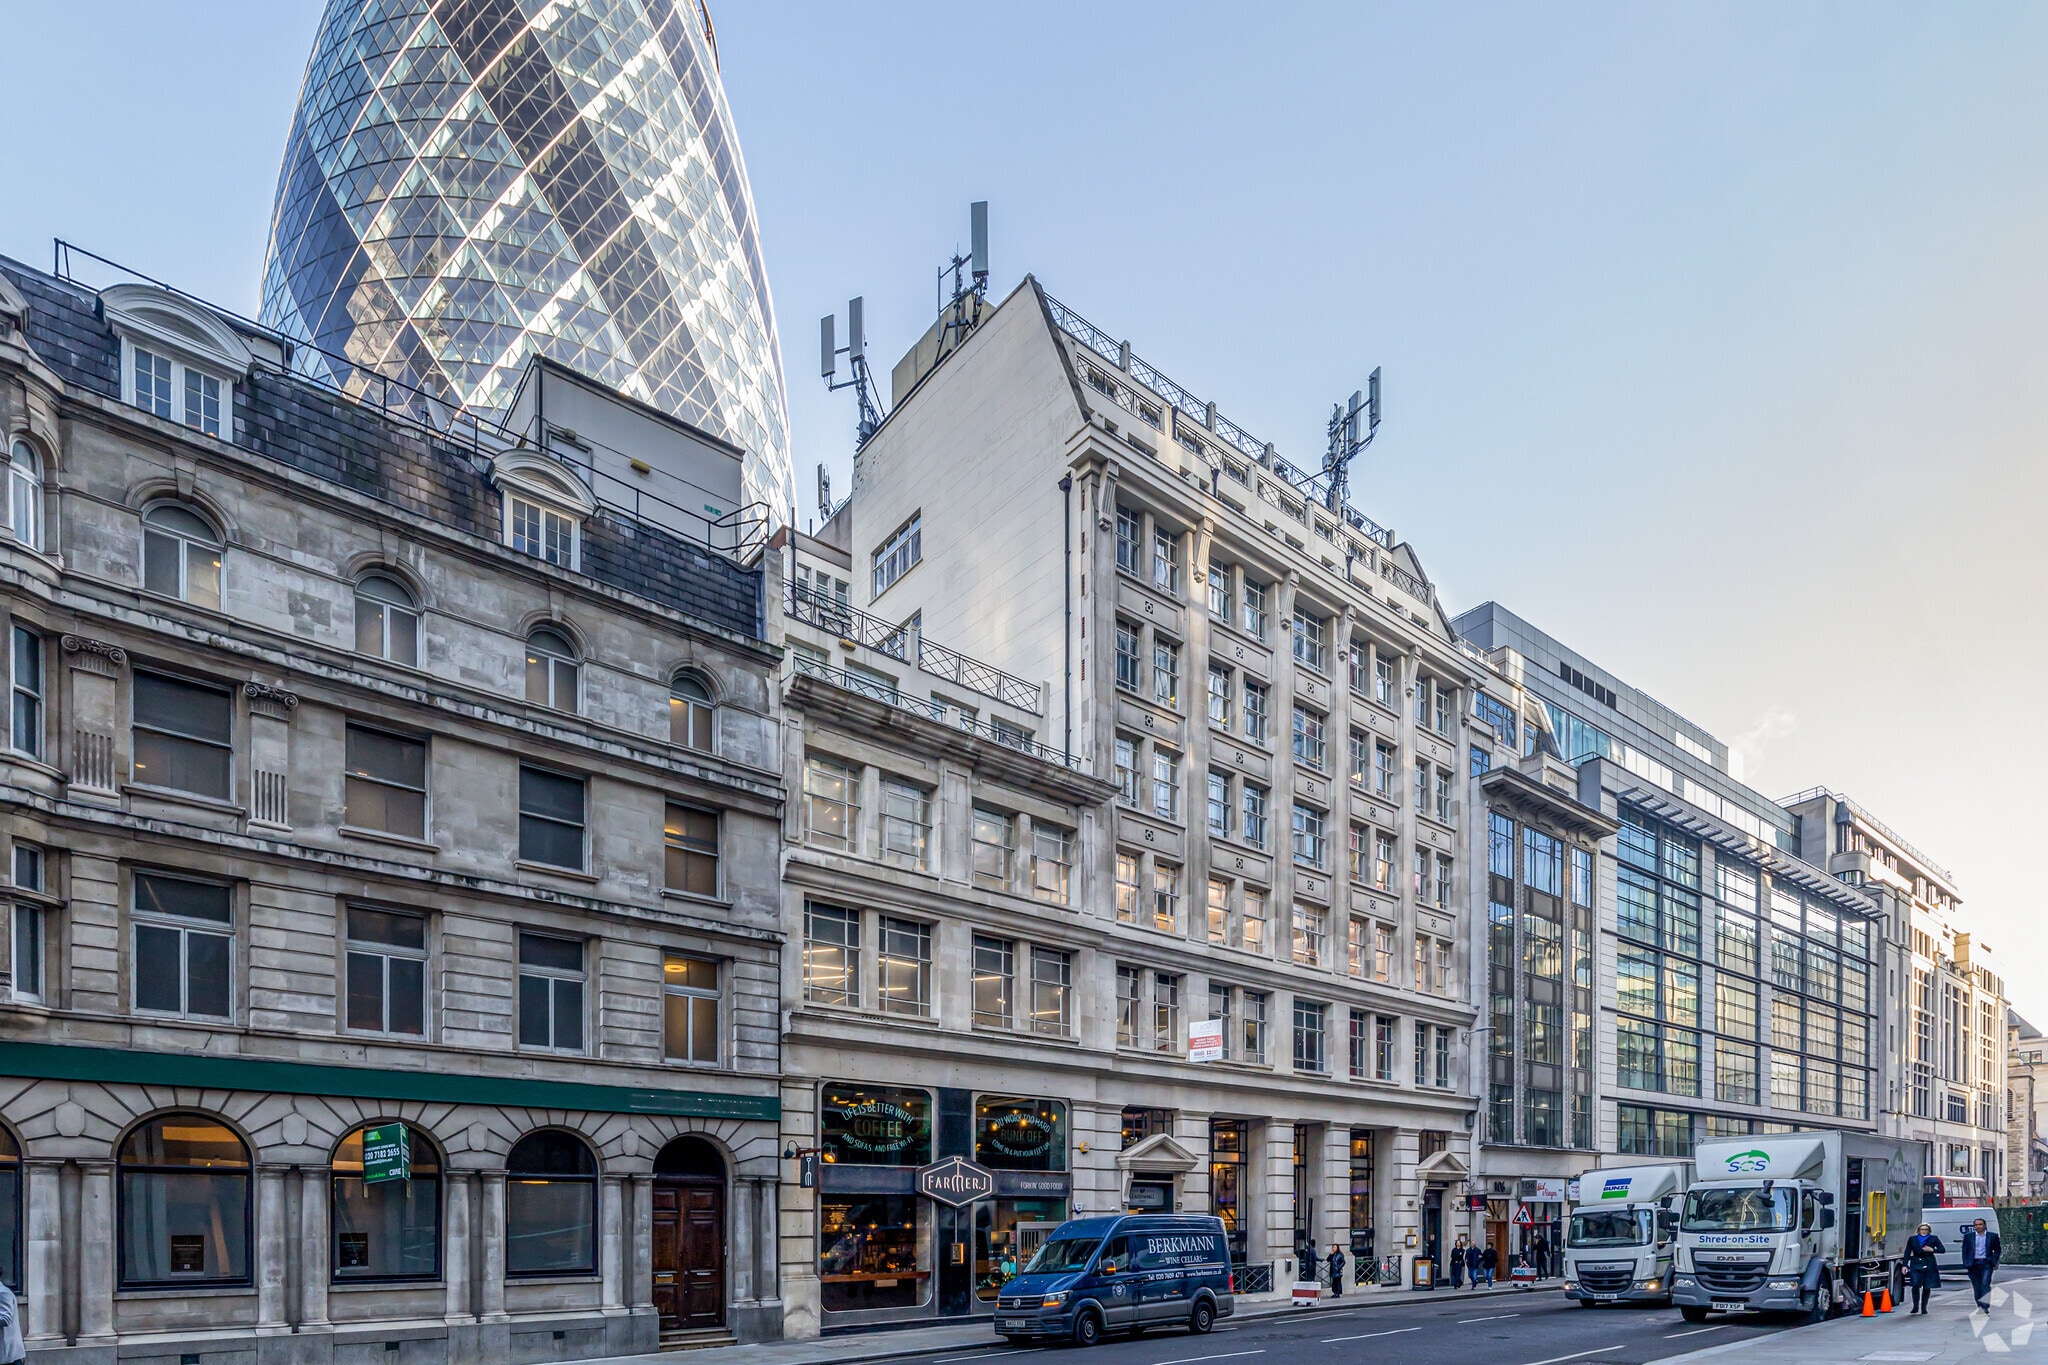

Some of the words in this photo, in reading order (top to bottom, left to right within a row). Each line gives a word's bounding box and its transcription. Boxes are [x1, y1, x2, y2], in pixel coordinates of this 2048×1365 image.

[842, 1106, 858, 1120] LIFE
[858, 1103, 866, 1114] IS
[867, 1103, 894, 1114] BETTER
[895, 1108, 914, 1124] WITH
[854, 1119, 902, 1137] COFFEE
[1004, 1114, 1022, 1124] WORK
[1035, 1118, 1050, 1132] HARD
[842, 1133, 854, 1144] AND
[887, 1142, 899, 1151] FREE
[1002, 1129, 1025, 1141] BUNK
[1027, 1130, 1043, 1141] OFF
[374, 1149, 386, 1159] 7182
[387, 1148, 400, 1157] 2655
[991, 1139, 1005, 1151] COME
[1034, 1146, 1044, 1155] FEET
[1521, 1181, 1534, 1190] 106
[1147, 1236, 1214, 1254] BERKMANN
[1181, 1255, 1202, 1263] CELLARS
